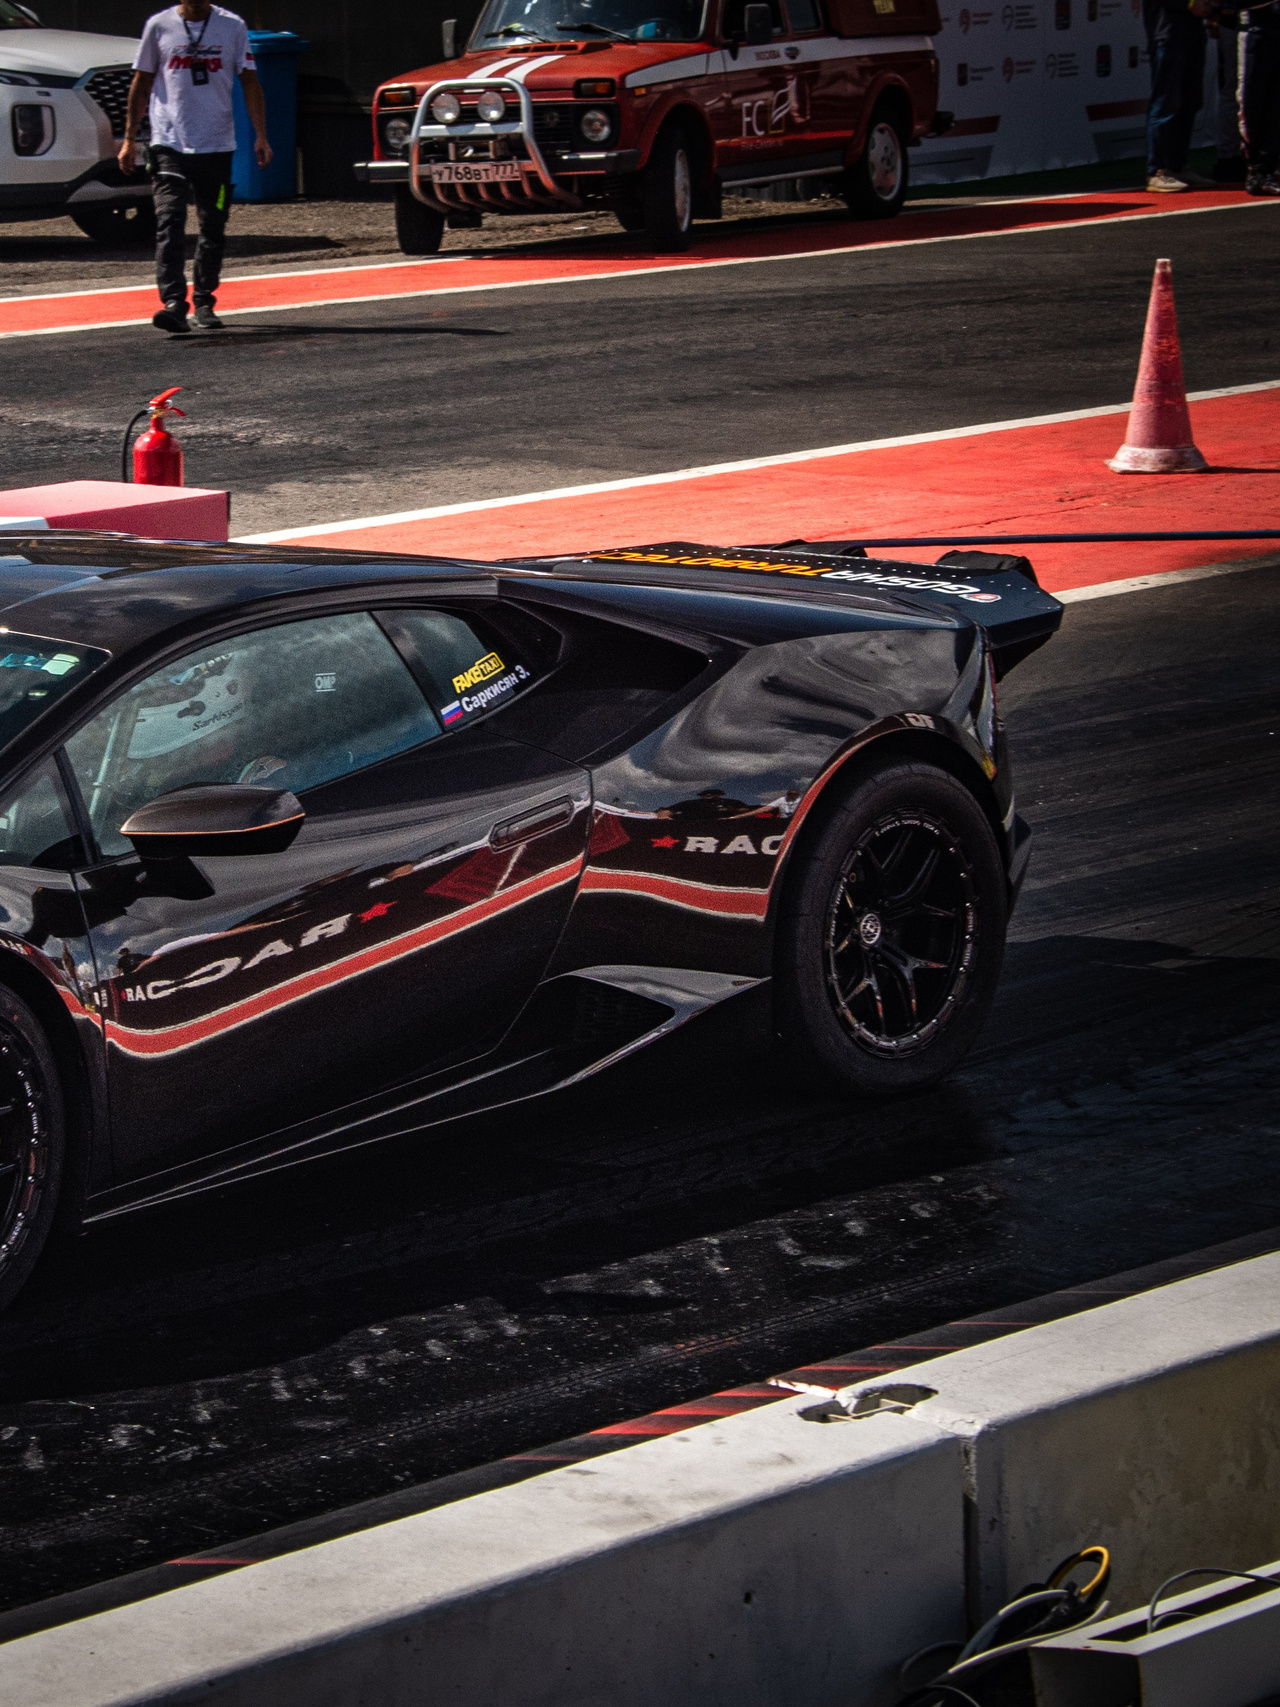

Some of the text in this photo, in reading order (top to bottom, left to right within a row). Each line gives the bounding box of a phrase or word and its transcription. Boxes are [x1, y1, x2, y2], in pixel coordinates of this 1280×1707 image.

[314, 675, 337, 690] OMP
[452, 665, 483, 694] FAKE
[461, 672, 519, 712] Саркисян
